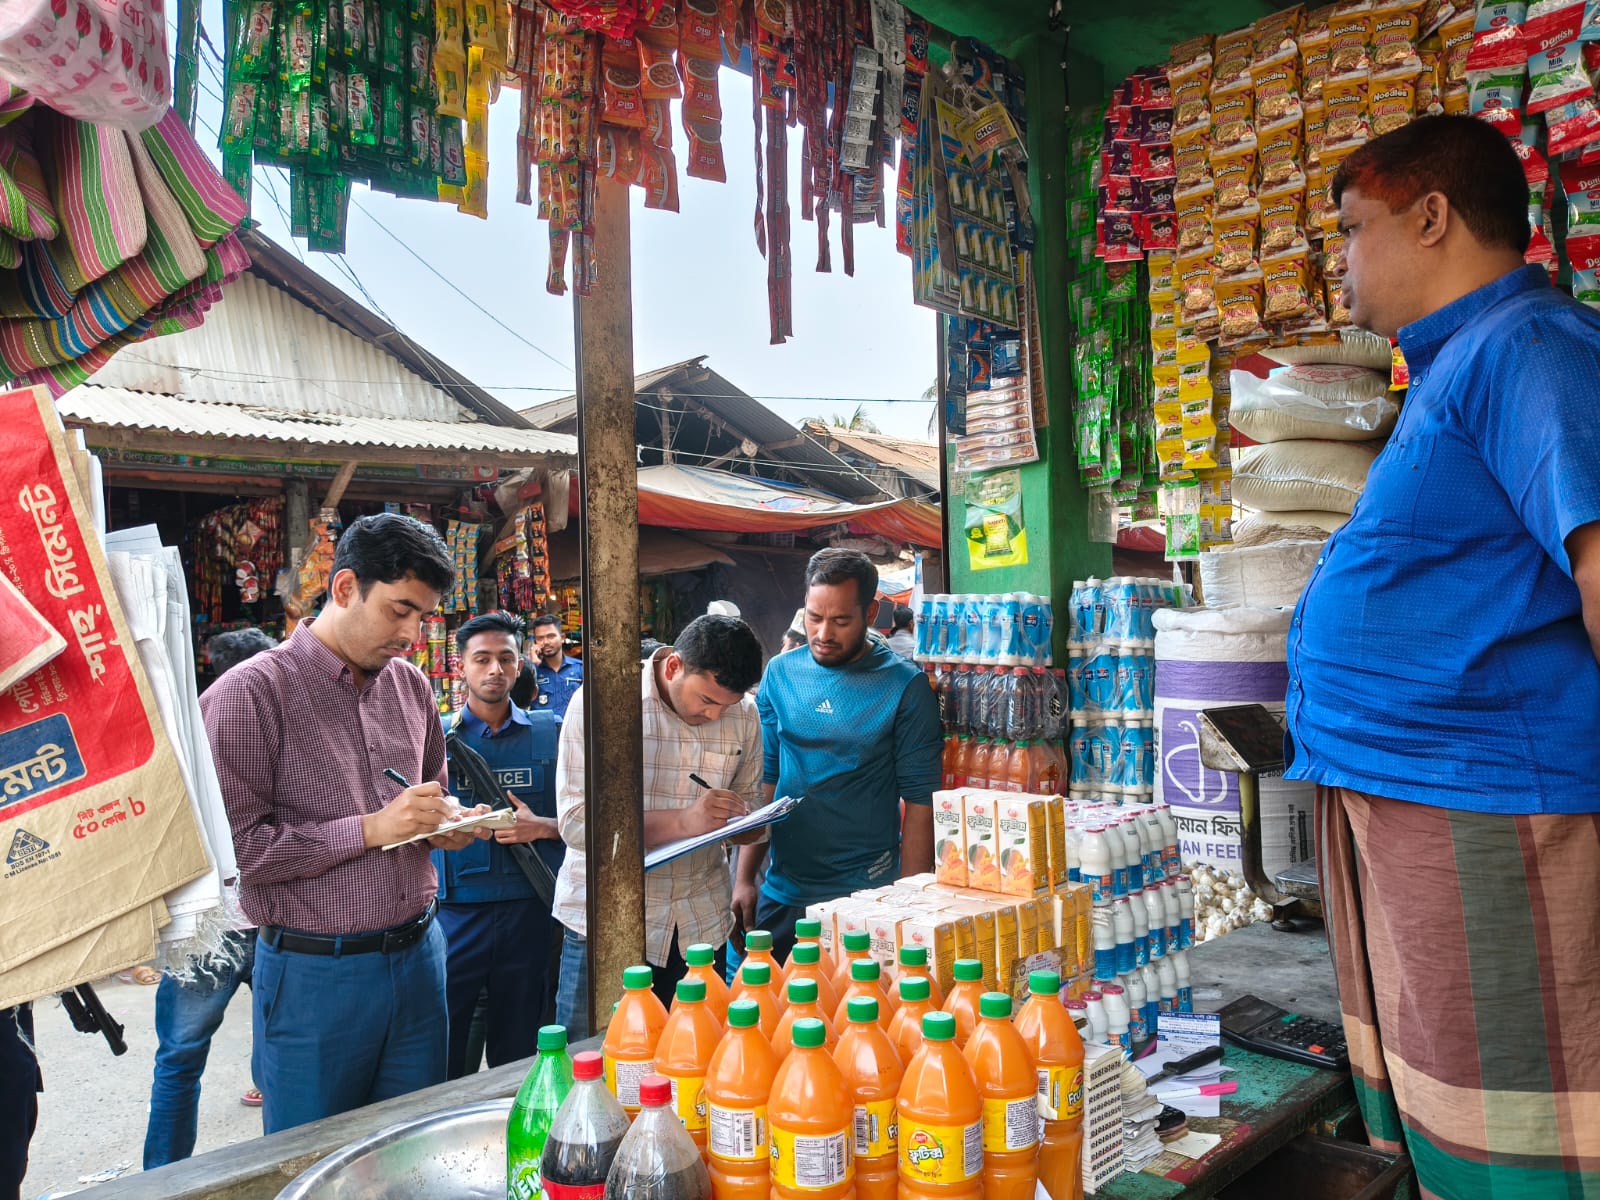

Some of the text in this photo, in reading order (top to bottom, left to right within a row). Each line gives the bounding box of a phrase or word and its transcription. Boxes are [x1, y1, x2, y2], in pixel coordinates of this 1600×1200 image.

[1334, 25, 1366, 37] Noodles
[1376, 19, 1411, 32] Noodles
[1446, 32, 1474, 48] Noodl
[1541, 29, 1573, 50] Danish
[1306, 53, 1328, 66] Nood
[1549, 58, 1562, 66] Milk
[1256, 73, 1287, 87] Noodles
[1328, 95, 1361, 105] Noodles
[1373, 90, 1408, 102] Noodles
[1214, 100, 1244, 113] Noodles
[1177, 144, 1204, 156] Noodles
[1262, 141, 1292, 154] Noodles
[1216, 165, 1246, 178] Noodles
[1578, 176, 1600, 190] Dani
[1178, 206, 1204, 217] Noodles
[1263, 205, 1294, 216] Noodles
[1219, 230, 1249, 240] Noodles
[1182, 269, 1210, 281] Noodles
[1267, 271, 1297, 281] Noodles
[1222, 295, 1253, 306] Noodles
[19, 483, 85, 600] সিমেন্ট
[0, 743, 66, 800] মেন্ট
[73, 811, 127, 839] ৫০ কেজি
[1173, 815, 1208, 834] মান
